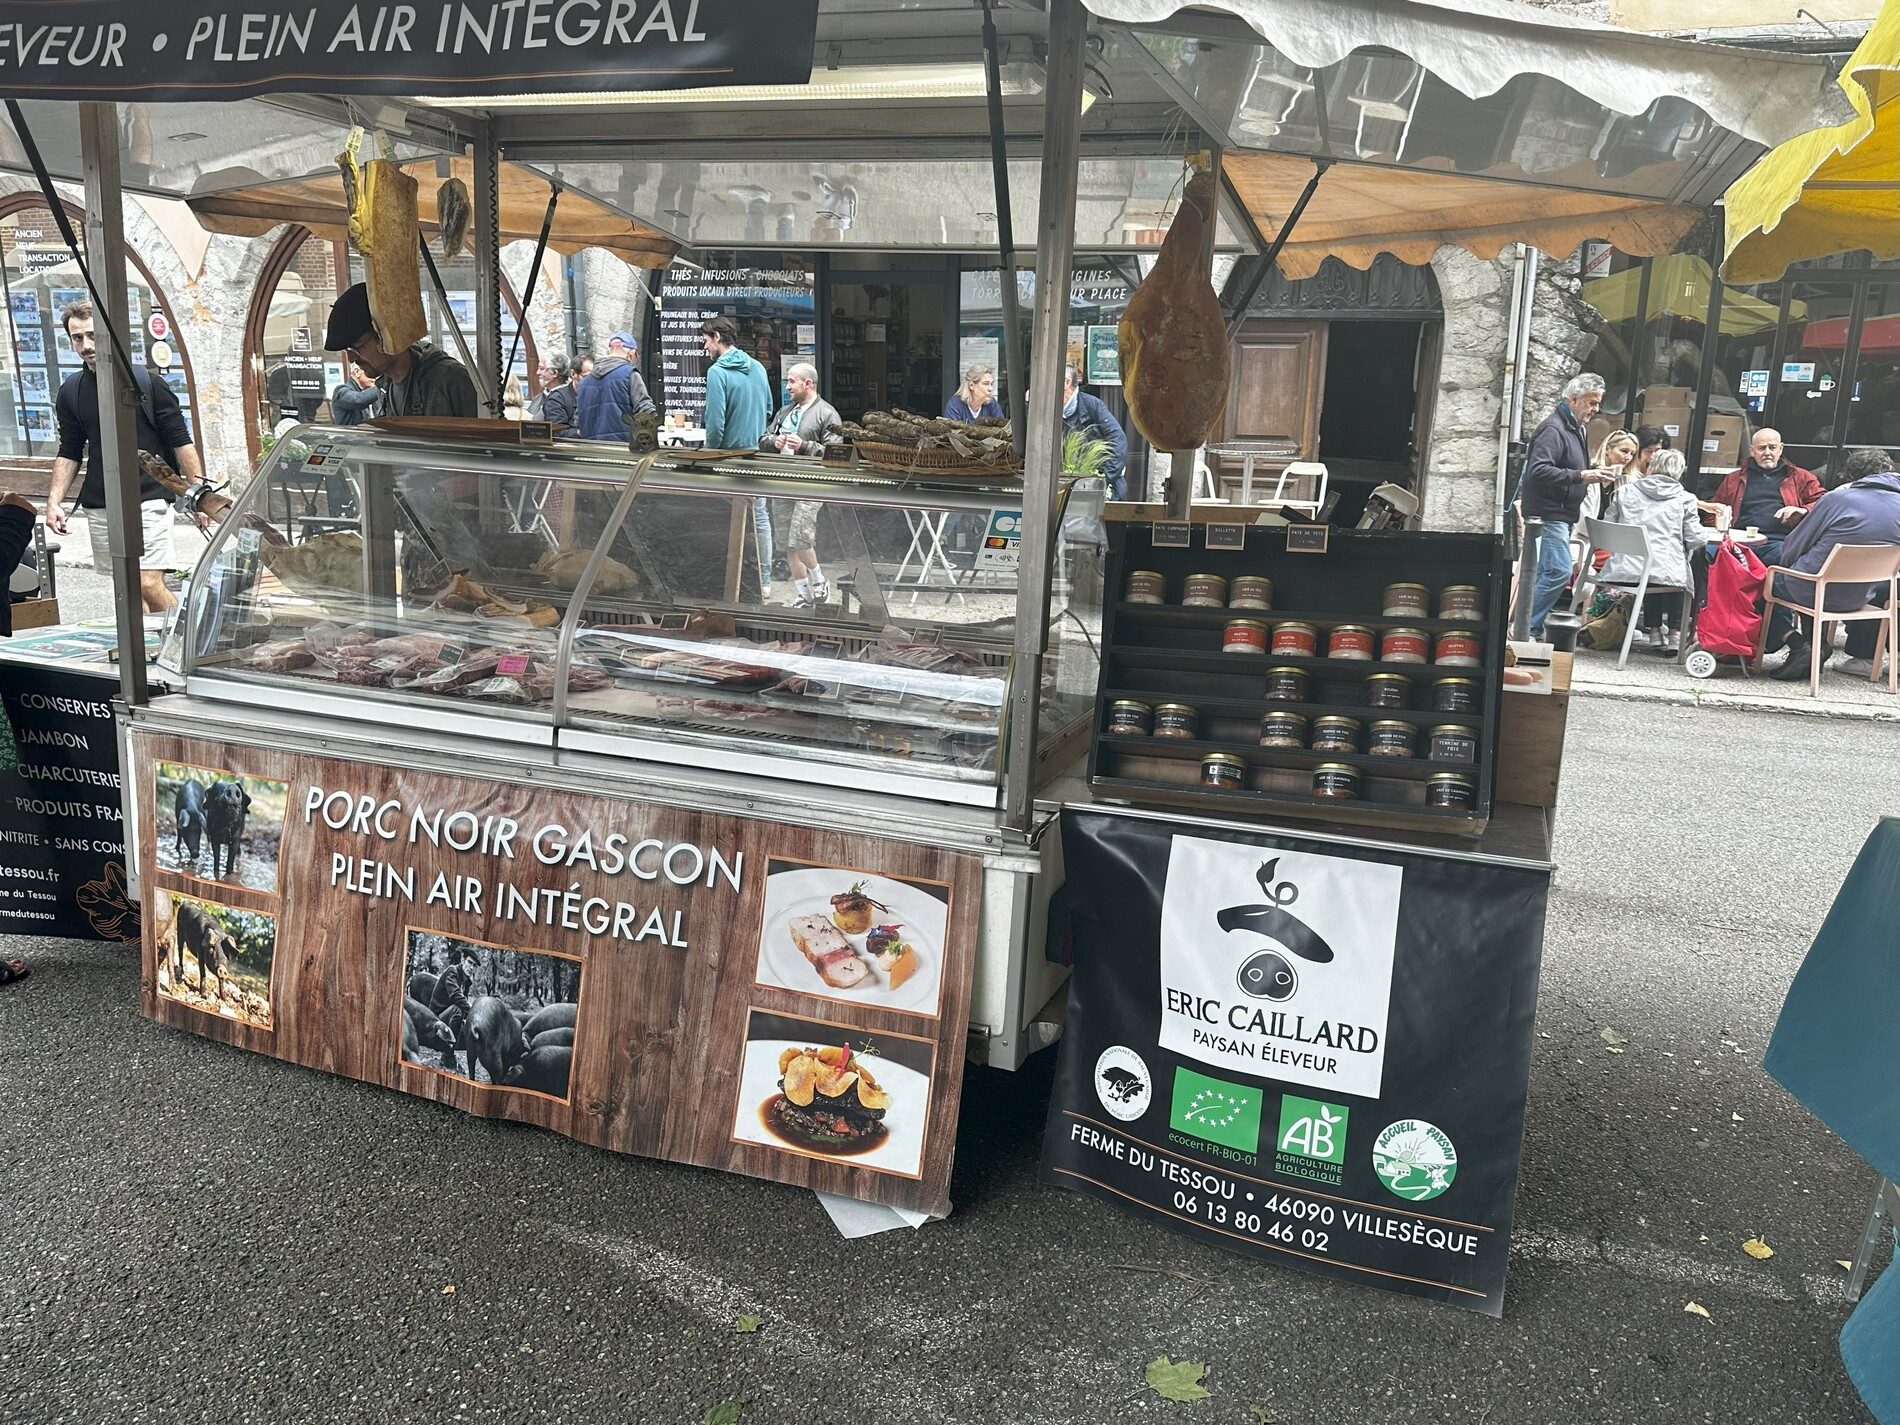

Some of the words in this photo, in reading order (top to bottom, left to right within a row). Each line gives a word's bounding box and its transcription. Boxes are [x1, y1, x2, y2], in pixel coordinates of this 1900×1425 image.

[186, 8, 317, 60] PLEIN
[326, 3, 417, 53] AIR
[15, 229, 43, 238] ANCIEN
[18, 254, 71, 262] TRANSACTION
[671, 268, 692, 281] THÉS
[701, 270, 747, 281] INFUSIONS
[756, 270, 804, 281] CHOCOLATS
[662, 286, 698, 298] PRODUITS
[700, 286, 725, 297] LOCAUX
[727, 286, 751, 297] DIRECT
[754, 286, 804, 298] PRODUCTEURS
[1091, 288, 1126, 300] PLACE
[20, 693, 111, 719] CONSERVES
[21, 728, 90, 751] JAMBON
[15, 796, 92, 818] PRODUITS
[95, 804, 124, 822] FRA
[55, 837, 90, 851] SANS
[304, 786, 402, 840] PORC
[410, 804, 518, 859] NOIR
[532, 824, 744, 894] GASCON
[13, 889, 24, 898] du
[28, 890, 57, 901] Tessou
[331, 852, 414, 902] PLEIN
[426, 870, 482, 915] AIR
[495, 882, 689, 948] INTÉGRAL
[1166, 988, 1221, 1024] ERIC
[1228, 1005, 1378, 1054] CAILLARD
[1193, 1028, 1254, 1058] PAYSAN
[1262, 1042, 1337, 1074] ÉLEVEUR
[1168, 1132, 1205, 1152] ecocert
[1206, 1144, 1258, 1166] FR-BIO-01
[1282, 1117, 1335, 1158] AB
[1378, 1122, 1417, 1149] ACCUEIL
[1426, 1127, 1455, 1160] PAYSAN
[1275, 1162, 1342, 1183] BIOLOGIQUE
[1276, 1154, 1343, 1174] AGRICULTURE
[1071, 1124, 1124, 1160] FERME
[1129, 1146, 1154, 1172] DU
[1160, 1158, 1236, 1200] TESSOU
[1264, 1194, 1334, 1226] 46090
[1342, 1210, 1478, 1256] VILLESÈQUE
[1174, 1191, 1198, 1214] 06
[1207, 1202, 1226, 1224] 13
[1234, 1210, 1261, 1233] 80
[1267, 1221, 1294, 1242] 46
[1302, 1228, 1329, 1252] 02
